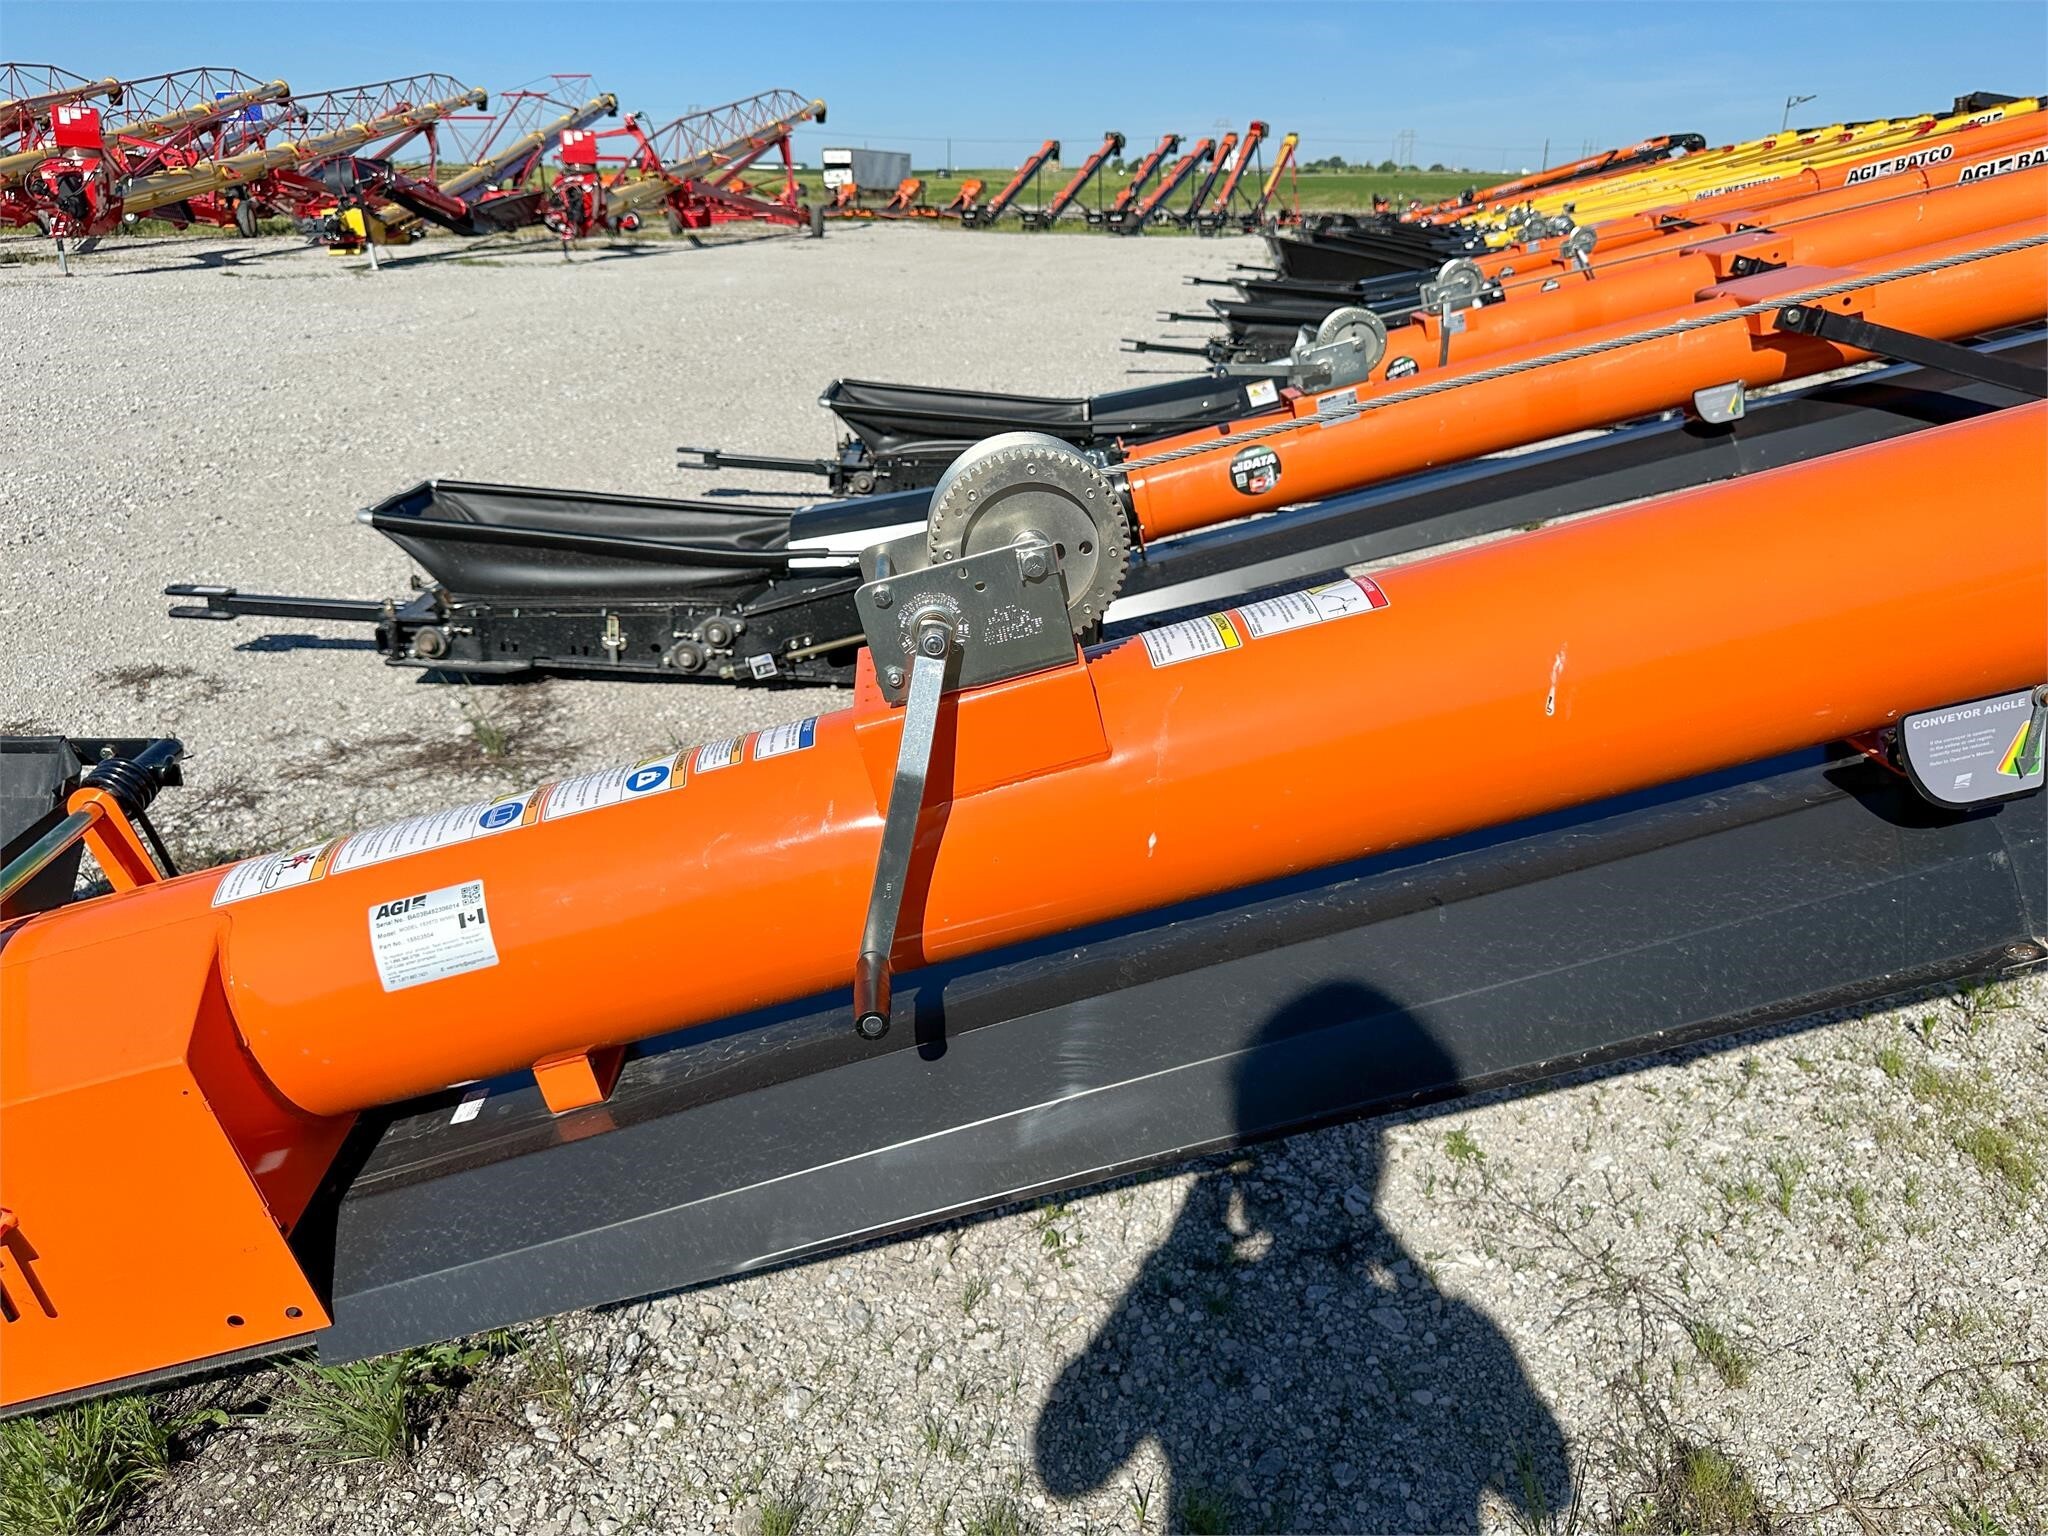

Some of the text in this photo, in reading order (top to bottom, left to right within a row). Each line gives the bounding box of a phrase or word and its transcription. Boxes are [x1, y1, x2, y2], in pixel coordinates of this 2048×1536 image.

[1848, 165, 1877, 184] AGI
[1895, 146, 1953, 172] BATCO
[1961, 147, 2048, 182] AGI BA
[1912, 698, 2026, 730] CONVEYOR ANGLE
[376, 898, 410, 920] AGI
[376, 919, 393, 929] Serial
